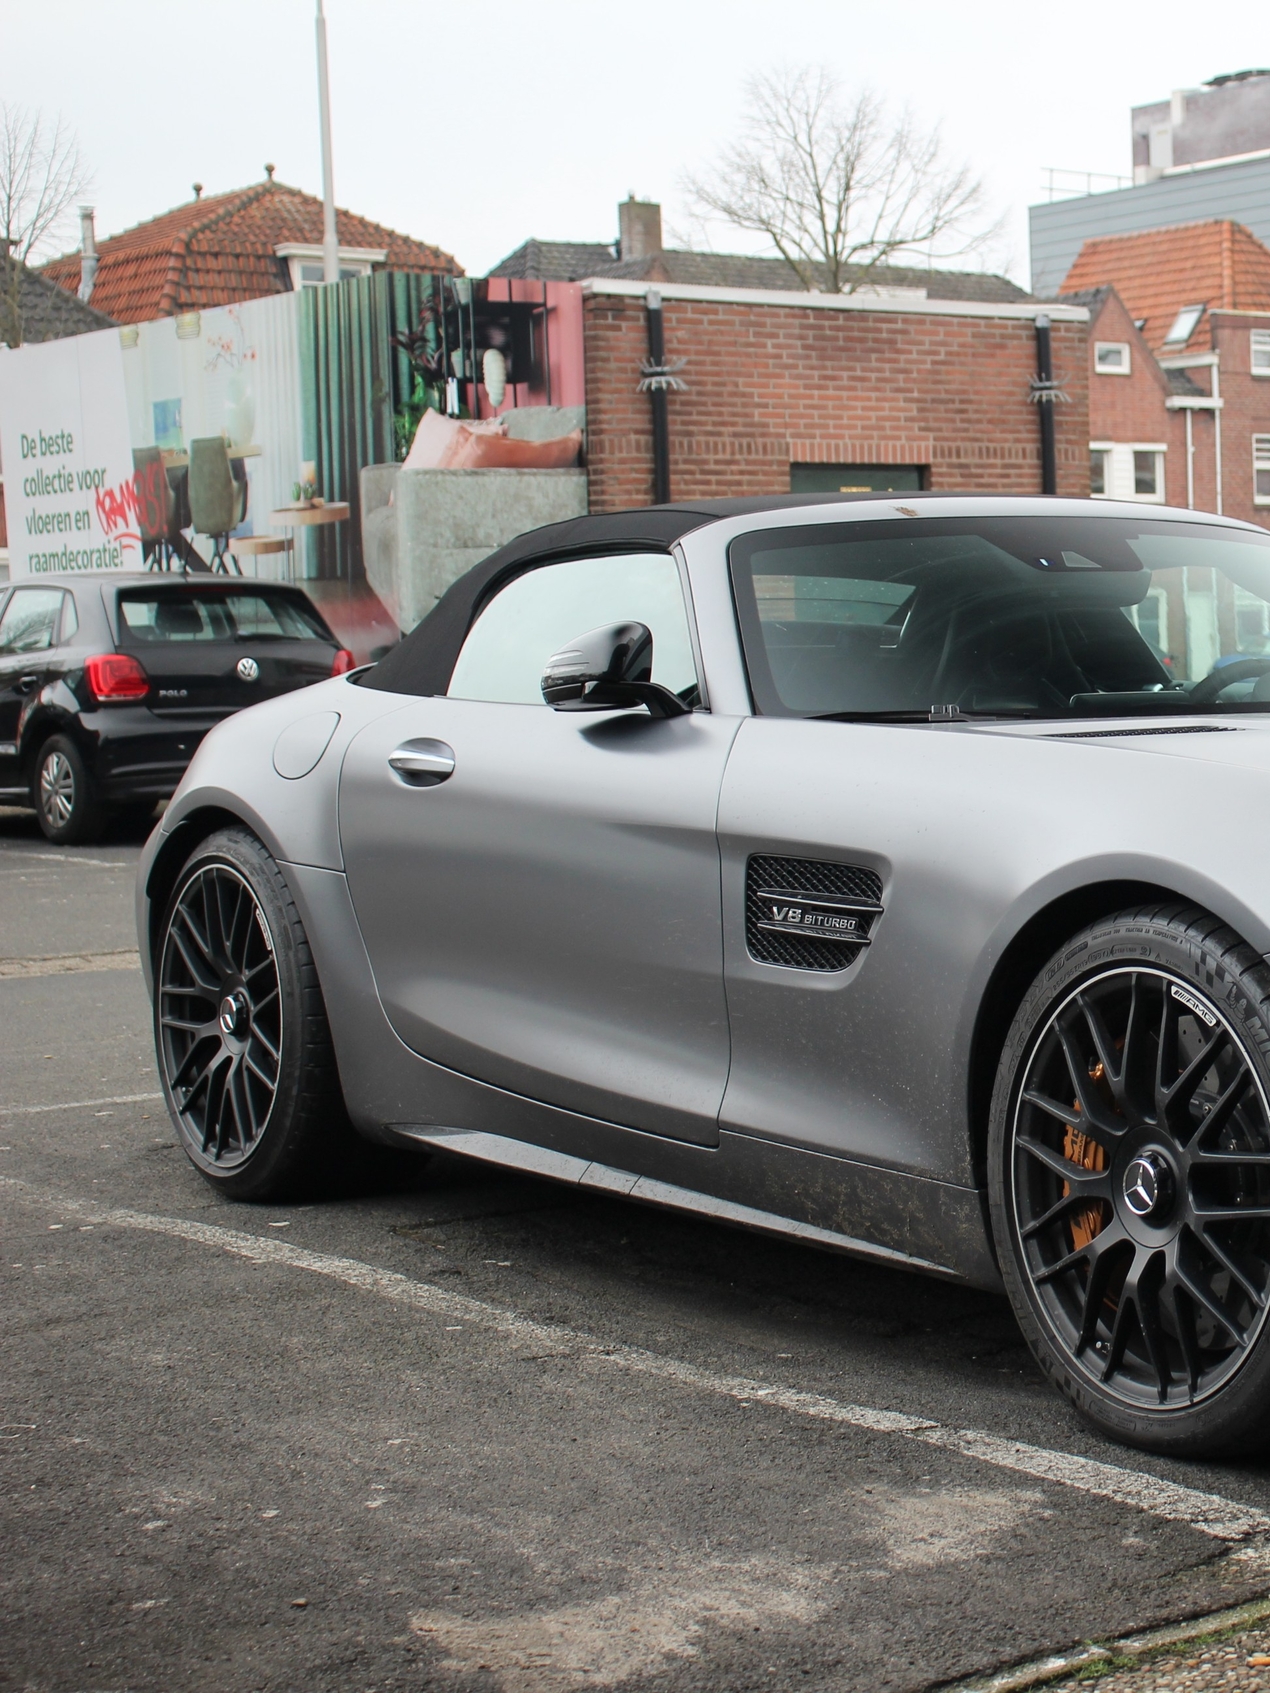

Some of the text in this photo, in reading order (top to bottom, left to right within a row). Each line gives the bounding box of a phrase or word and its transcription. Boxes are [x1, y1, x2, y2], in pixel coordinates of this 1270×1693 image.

[20, 429, 74, 459] De beste
[23, 465, 107, 497] collectie voor
[26, 508, 91, 535] vloeren en
[28, 539, 124, 573] raamdecoratie!
[159, 689, 188, 697] POLO
[772, 906, 857, 930] V8 BITURBO
[1186, 998, 1214, 1024] AMG
